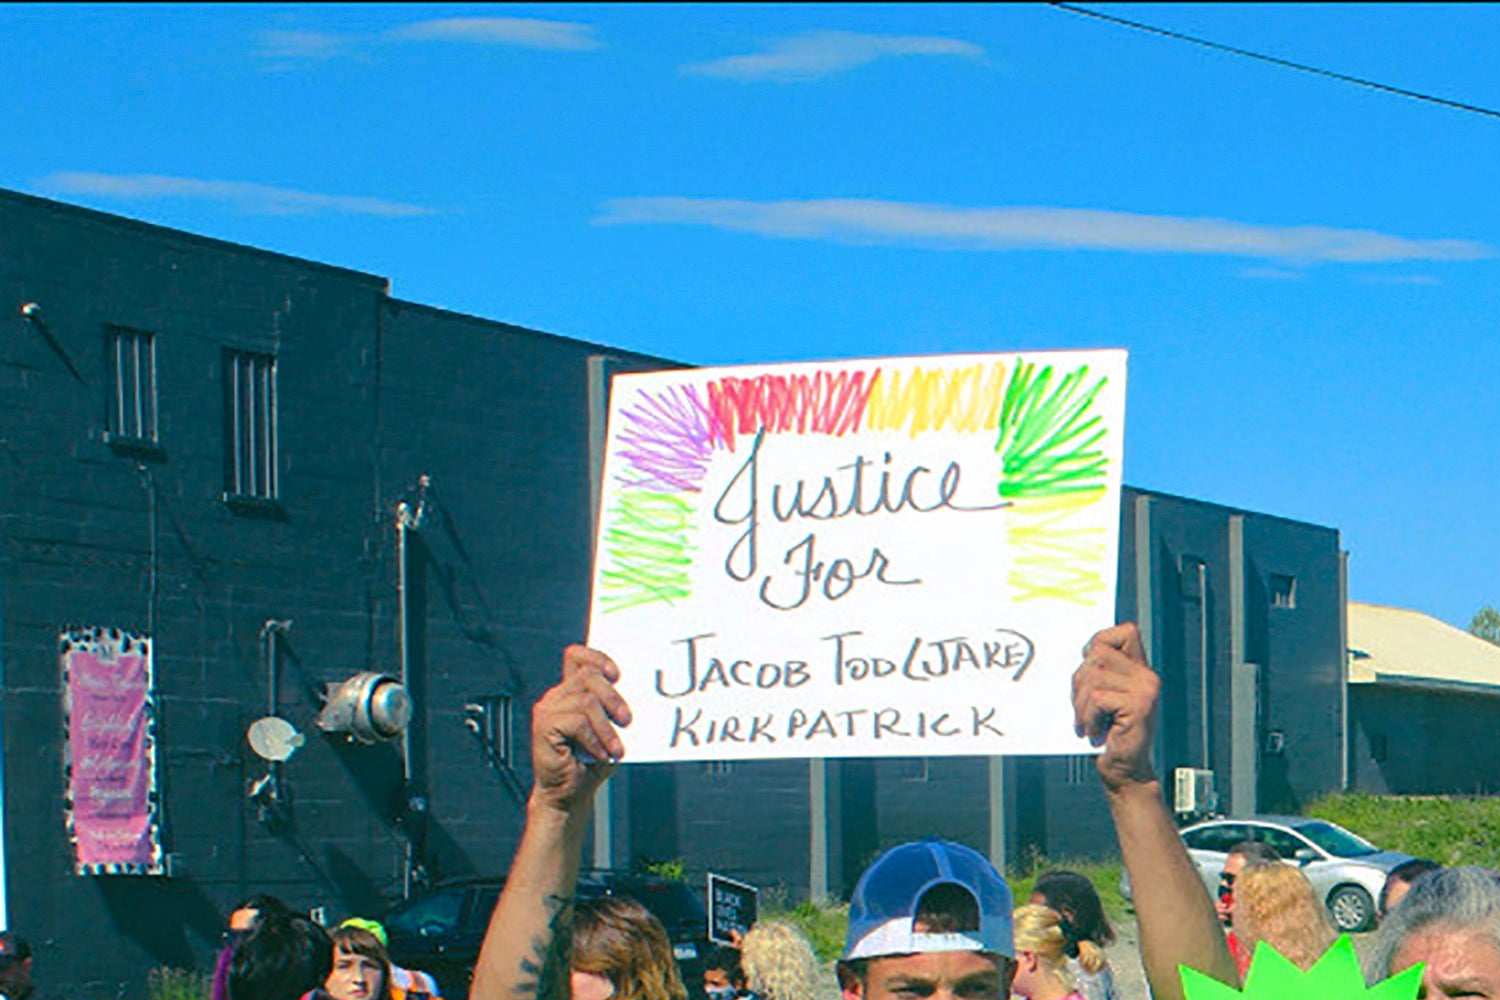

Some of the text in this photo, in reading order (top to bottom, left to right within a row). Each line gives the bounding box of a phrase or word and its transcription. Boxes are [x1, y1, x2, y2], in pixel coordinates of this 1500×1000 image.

[714, 426, 1014, 581] Justice
[760, 534, 922, 611] For
[655, 633, 811, 698] JACOB
